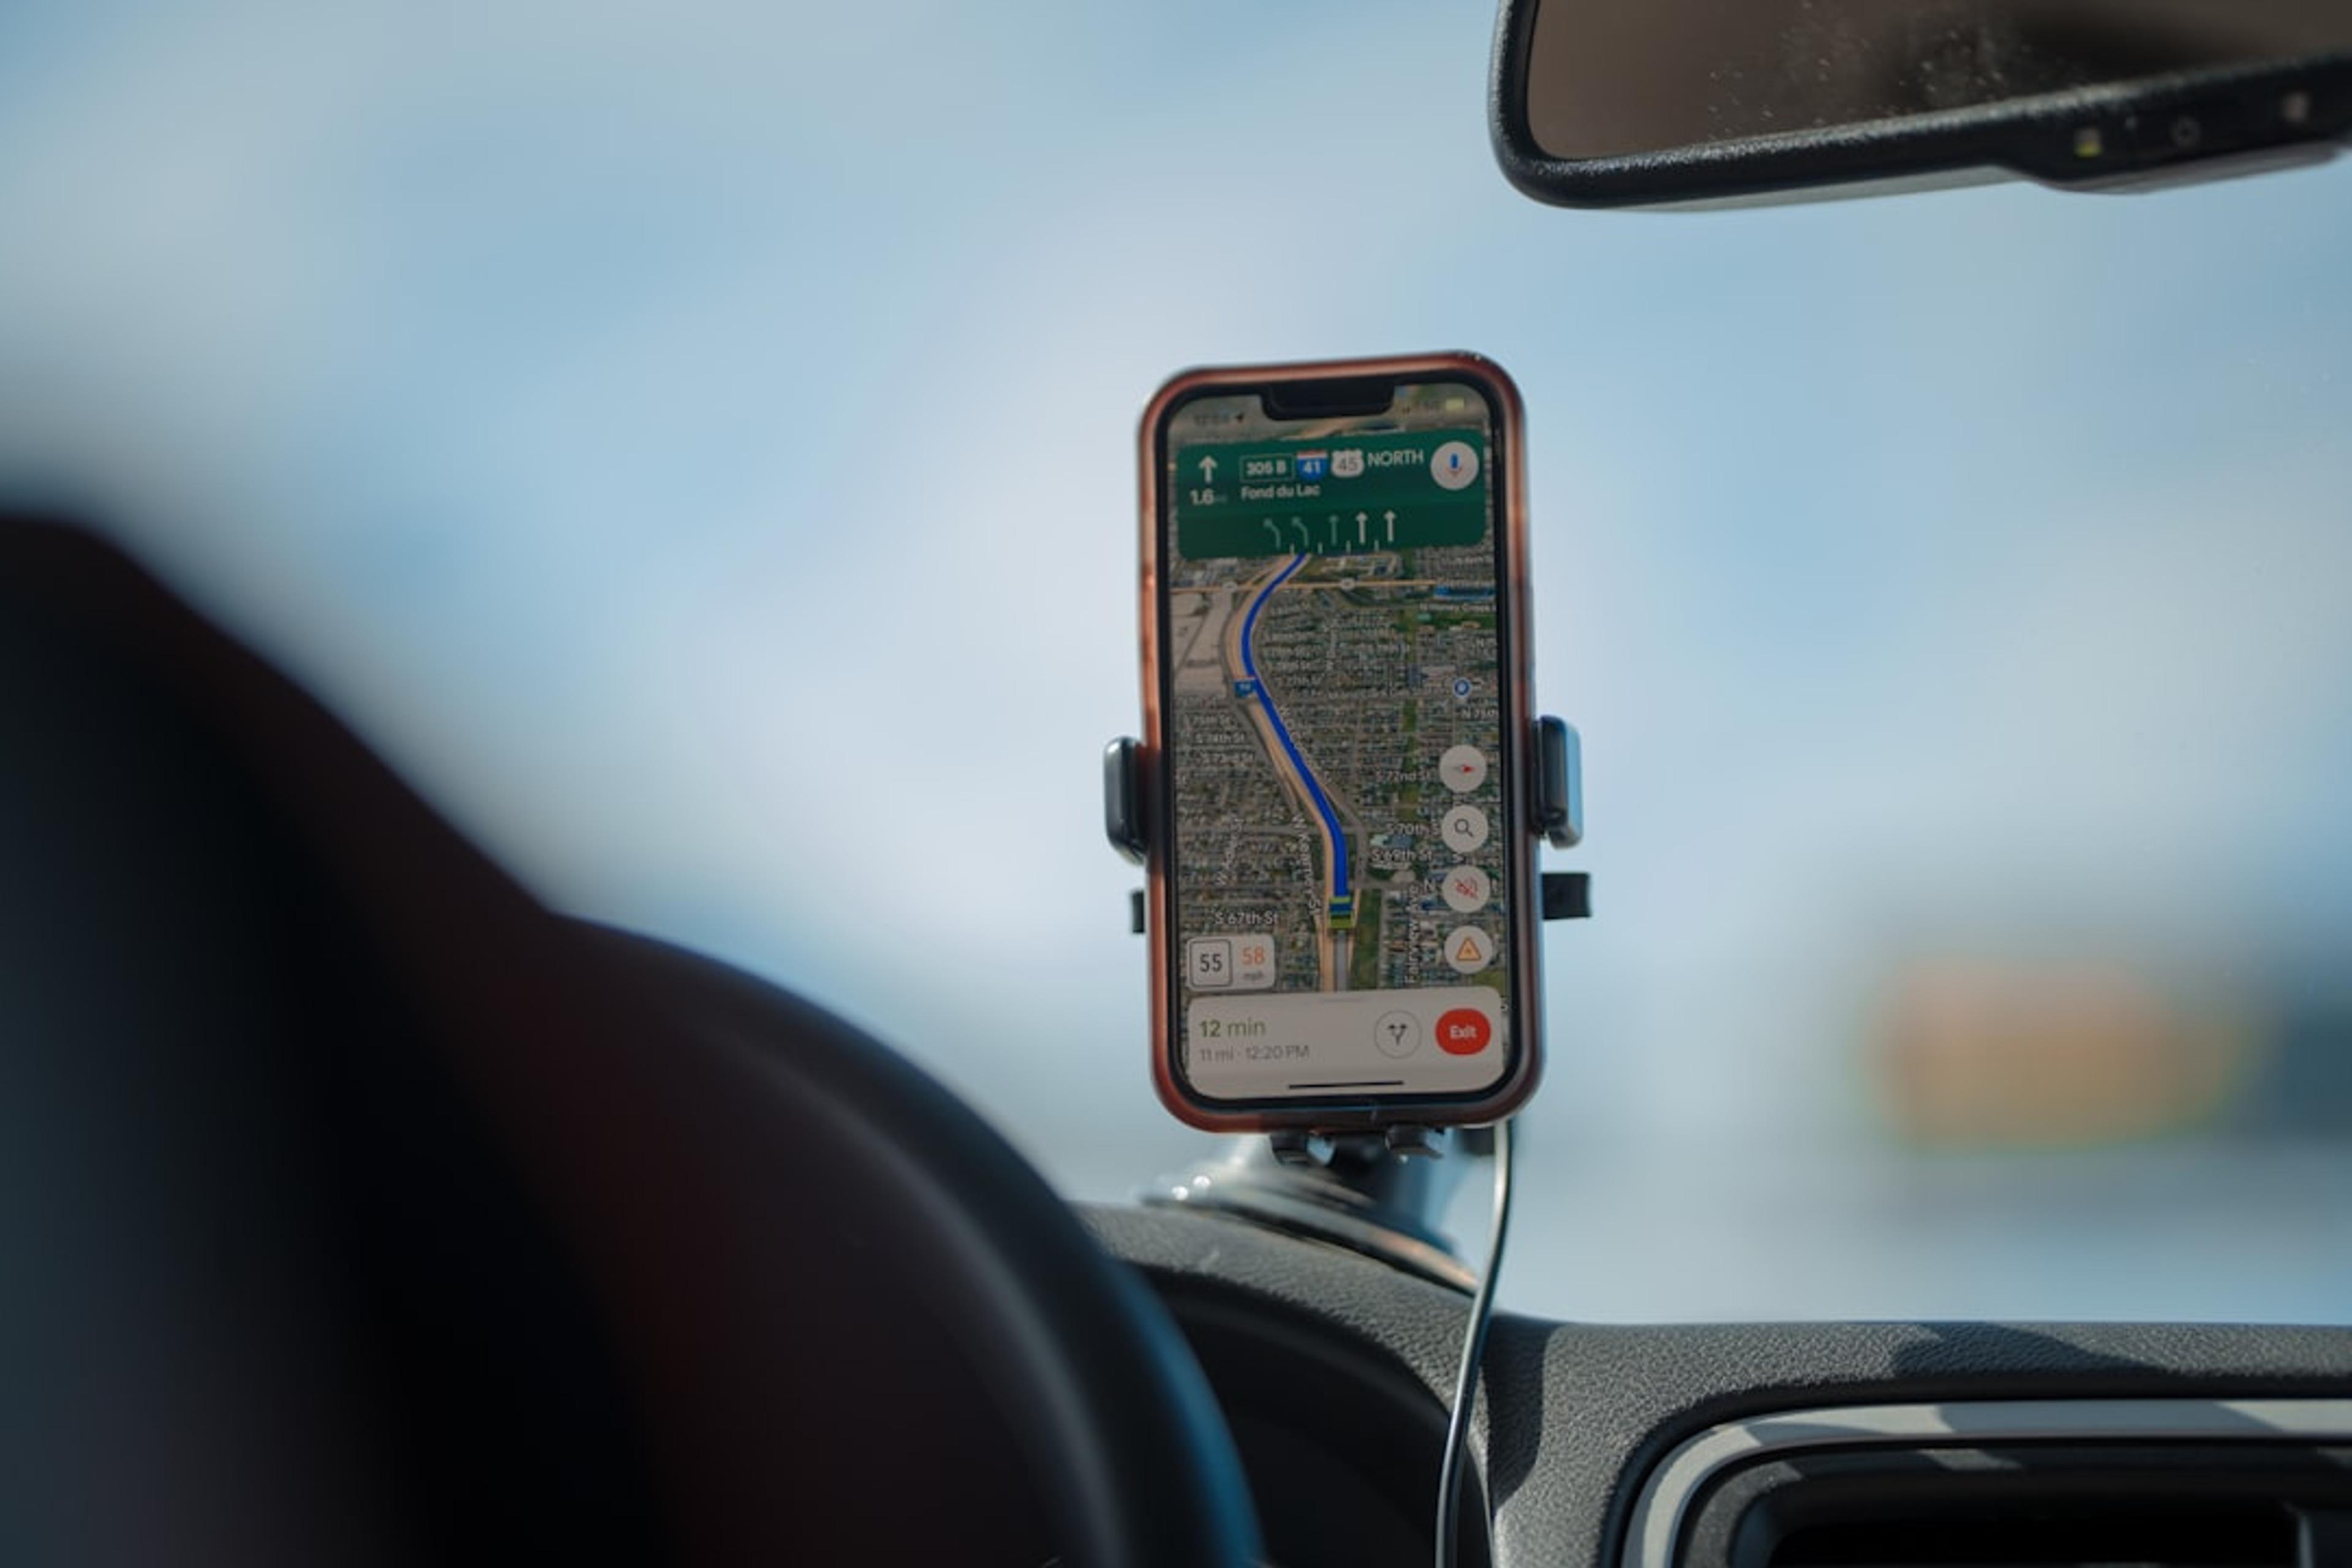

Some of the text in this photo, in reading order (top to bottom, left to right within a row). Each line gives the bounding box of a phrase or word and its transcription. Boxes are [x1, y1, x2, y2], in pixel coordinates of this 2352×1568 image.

[1246, 450, 1424, 477] 305 B 41 45 NORTH
[1241, 486, 1274, 500] Fond
[1276, 484, 1294, 498] du
[1296, 483, 1321, 497] Lac
[1215, 910, 1280, 925] S 67th St
[1199, 953, 1223, 972] 55
[1240, 946, 1265, 965] 58
[1200, 1018, 1266, 1038] 12 min
[1449, 1024, 1477, 1039] Exit
[1200, 1045, 1310, 1061] 11 mi 12:20 PM
